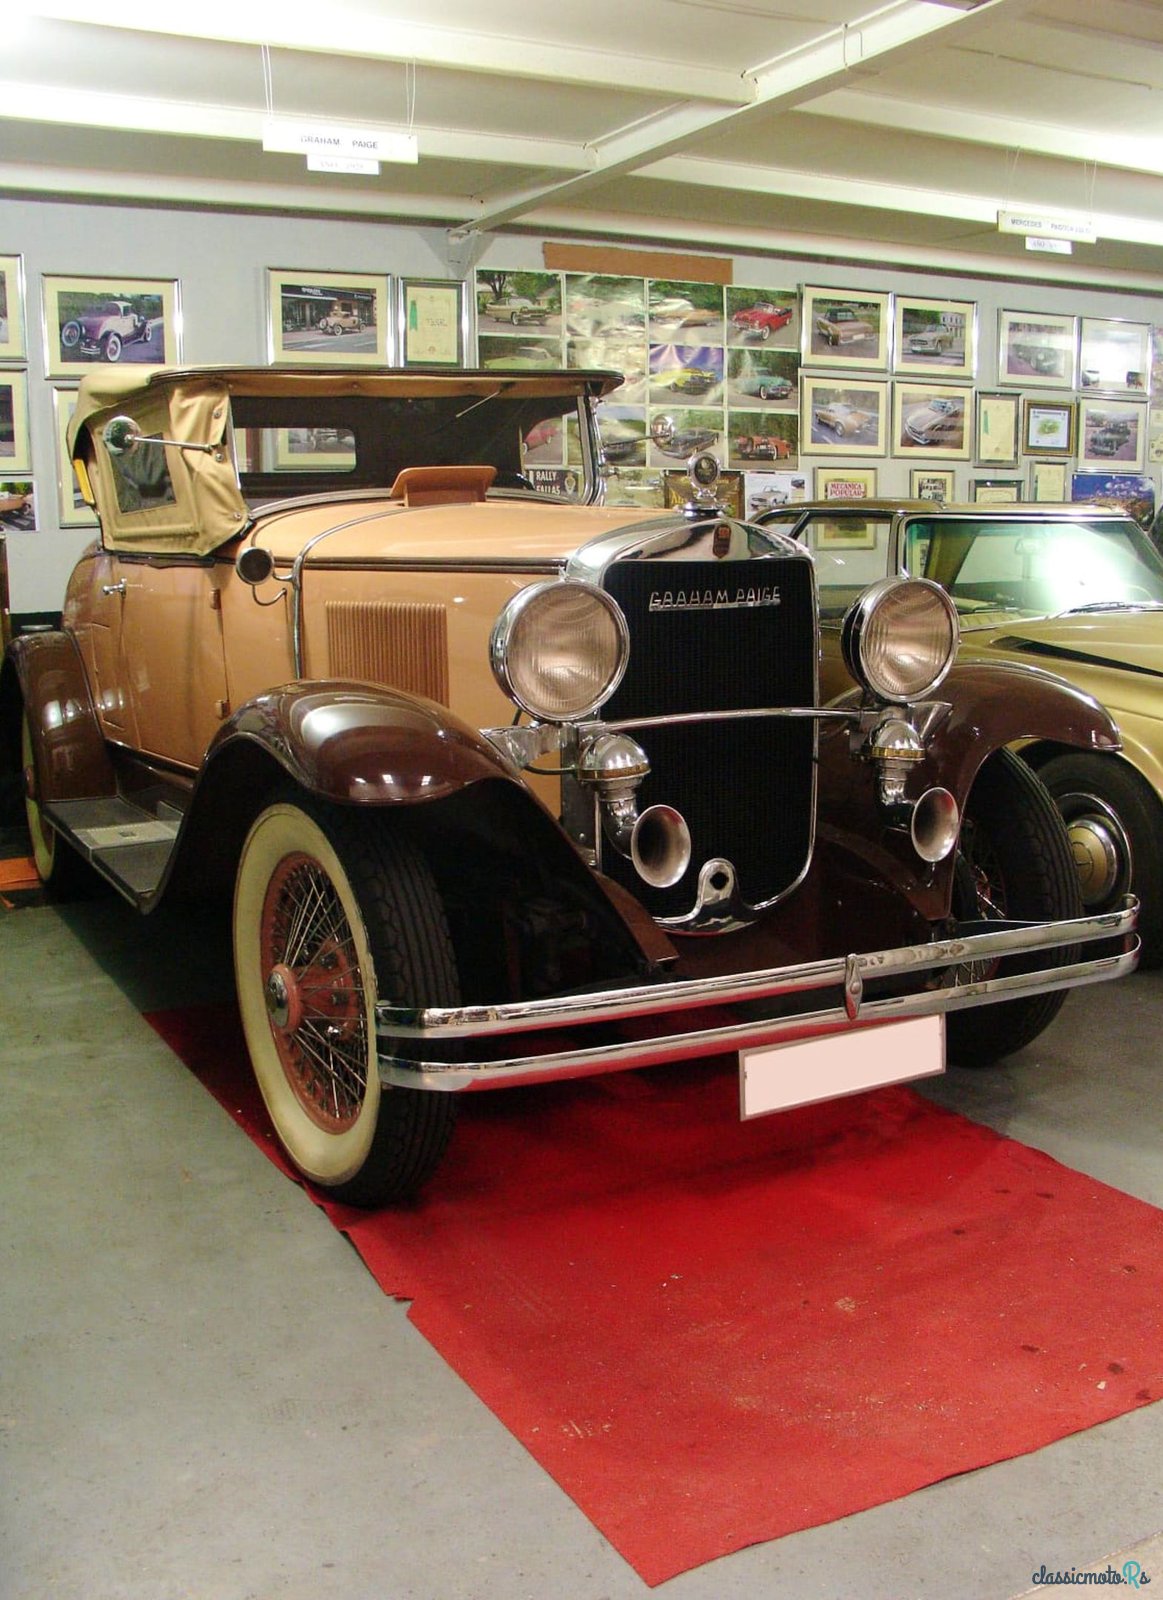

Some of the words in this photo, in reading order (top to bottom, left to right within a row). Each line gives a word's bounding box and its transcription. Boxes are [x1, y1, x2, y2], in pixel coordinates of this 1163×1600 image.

[301, 136, 340, 146] GRAHAM
[352, 140, 379, 149] PAIGE
[536, 471, 557, 481] RALLY
[649, 590, 729, 609] GRAHAM
[736, 586, 780, 604] PAIGE
